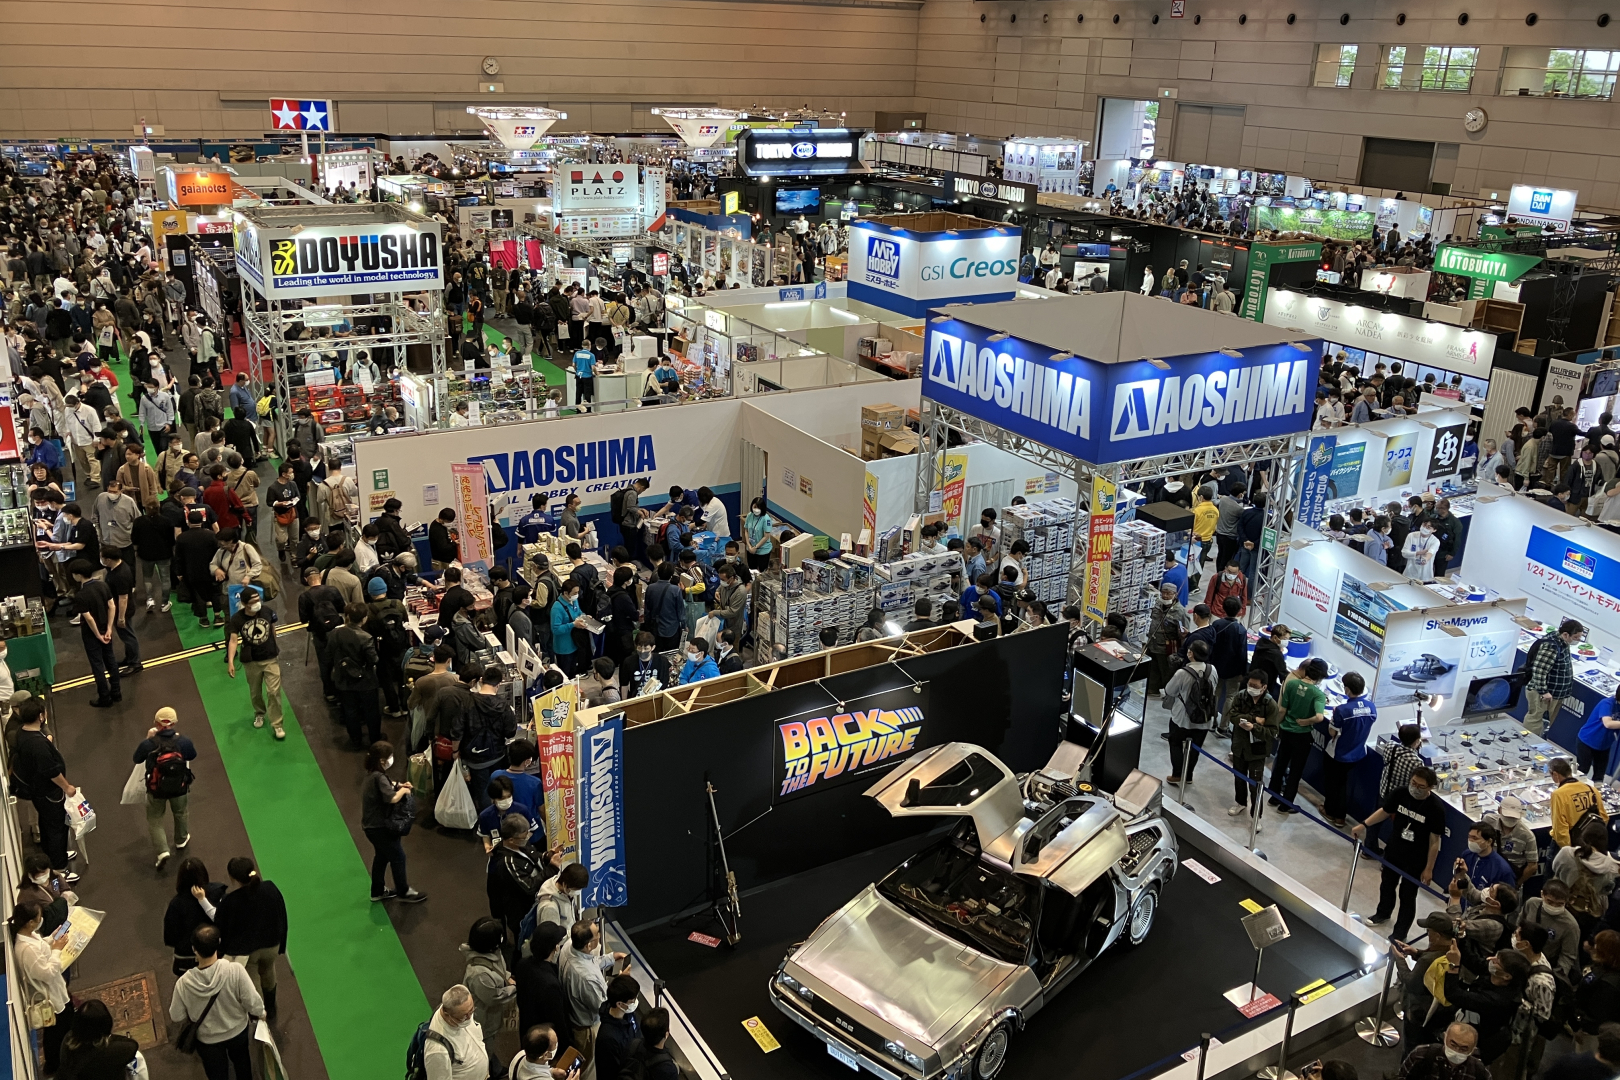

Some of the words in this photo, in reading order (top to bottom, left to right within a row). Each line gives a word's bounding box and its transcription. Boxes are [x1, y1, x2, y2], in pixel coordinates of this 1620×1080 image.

[180, 183, 227, 196] gaianotes
[571, 187, 625, 196] PLATZ
[954, 178, 980, 194] TOKYO
[998, 184, 1026, 203] MARUI
[1534, 194, 1552, 203] BAN
[1532, 202, 1546, 210] DAI
[298, 232, 438, 274] DOYUSHA
[1440, 248, 1507, 277] KOTOBUKIYA
[868, 255, 899, 276] HOBBY
[921, 266, 944, 281] GSI
[950, 257, 1018, 279] Creos
[278, 277, 312, 288] Leading
[313, 276, 327, 284] the
[328, 274, 352, 283] world
[354, 274, 362, 282] in
[364, 272, 388, 282] model
[865, 274, 900, 290] ミスターホビー
[1355, 328, 1382, 340] NADEA
[1356, 320, 1378, 330] ARCA
[1446, 344, 1466, 354] FRAME
[959, 340, 1091, 440] AOSHIMA
[1153, 360, 1308, 436] AOSHIMA
[511, 434, 656, 490] AOSHIMA
[1388, 446, 1412, 461] ワークス
[1527, 562, 1544, 578] 1/24
[1548, 572, 1620, 612] プリペイントモデル
[1470, 644, 1498, 658] US-2
[778, 708, 900, 763] BACK
[786, 756, 810, 779] TO
[806, 726, 922, 786] FUTURE
[780, 772, 809, 796] THE
[590, 758, 616, 872] AOSHIMA
